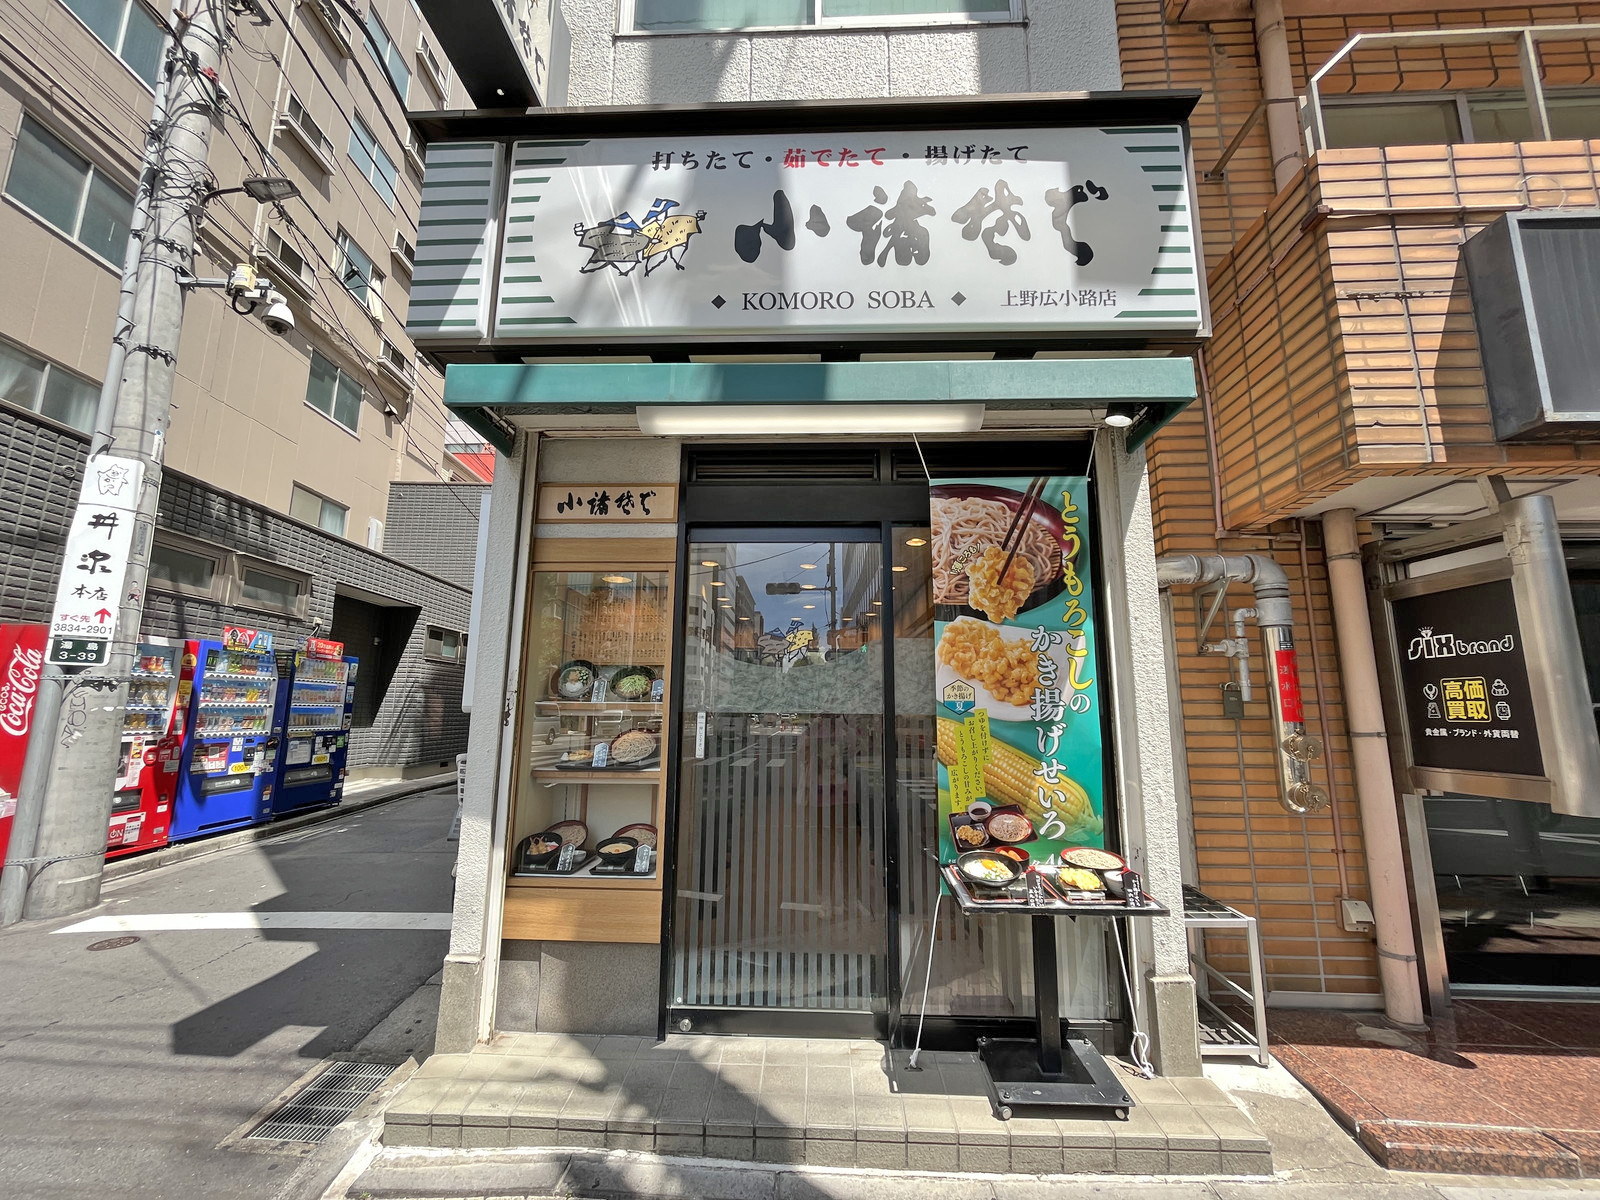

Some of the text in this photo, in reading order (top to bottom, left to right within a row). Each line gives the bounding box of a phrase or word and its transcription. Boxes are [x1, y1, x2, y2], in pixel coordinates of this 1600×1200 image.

[742, 289, 936, 311] KOMORO SOBA
[1000, 288, 1118, 309] 上野広小路店
[71, 584, 109, 602] 本店
[1059, 490, 1095, 715] とうもろこしの
[60, 613, 91, 624] すぐ先
[54, 623, 113, 636] 3834-2901
[1456, 634, 1515, 656] brand
[58, 651, 98, 662] 3-39
[1442, 680, 1486, 700] 高価
[955, 701, 965, 711] 夏
[1446, 700, 1489, 720] 買取
[1029, 624, 1068, 841] かき揚げせいろ
